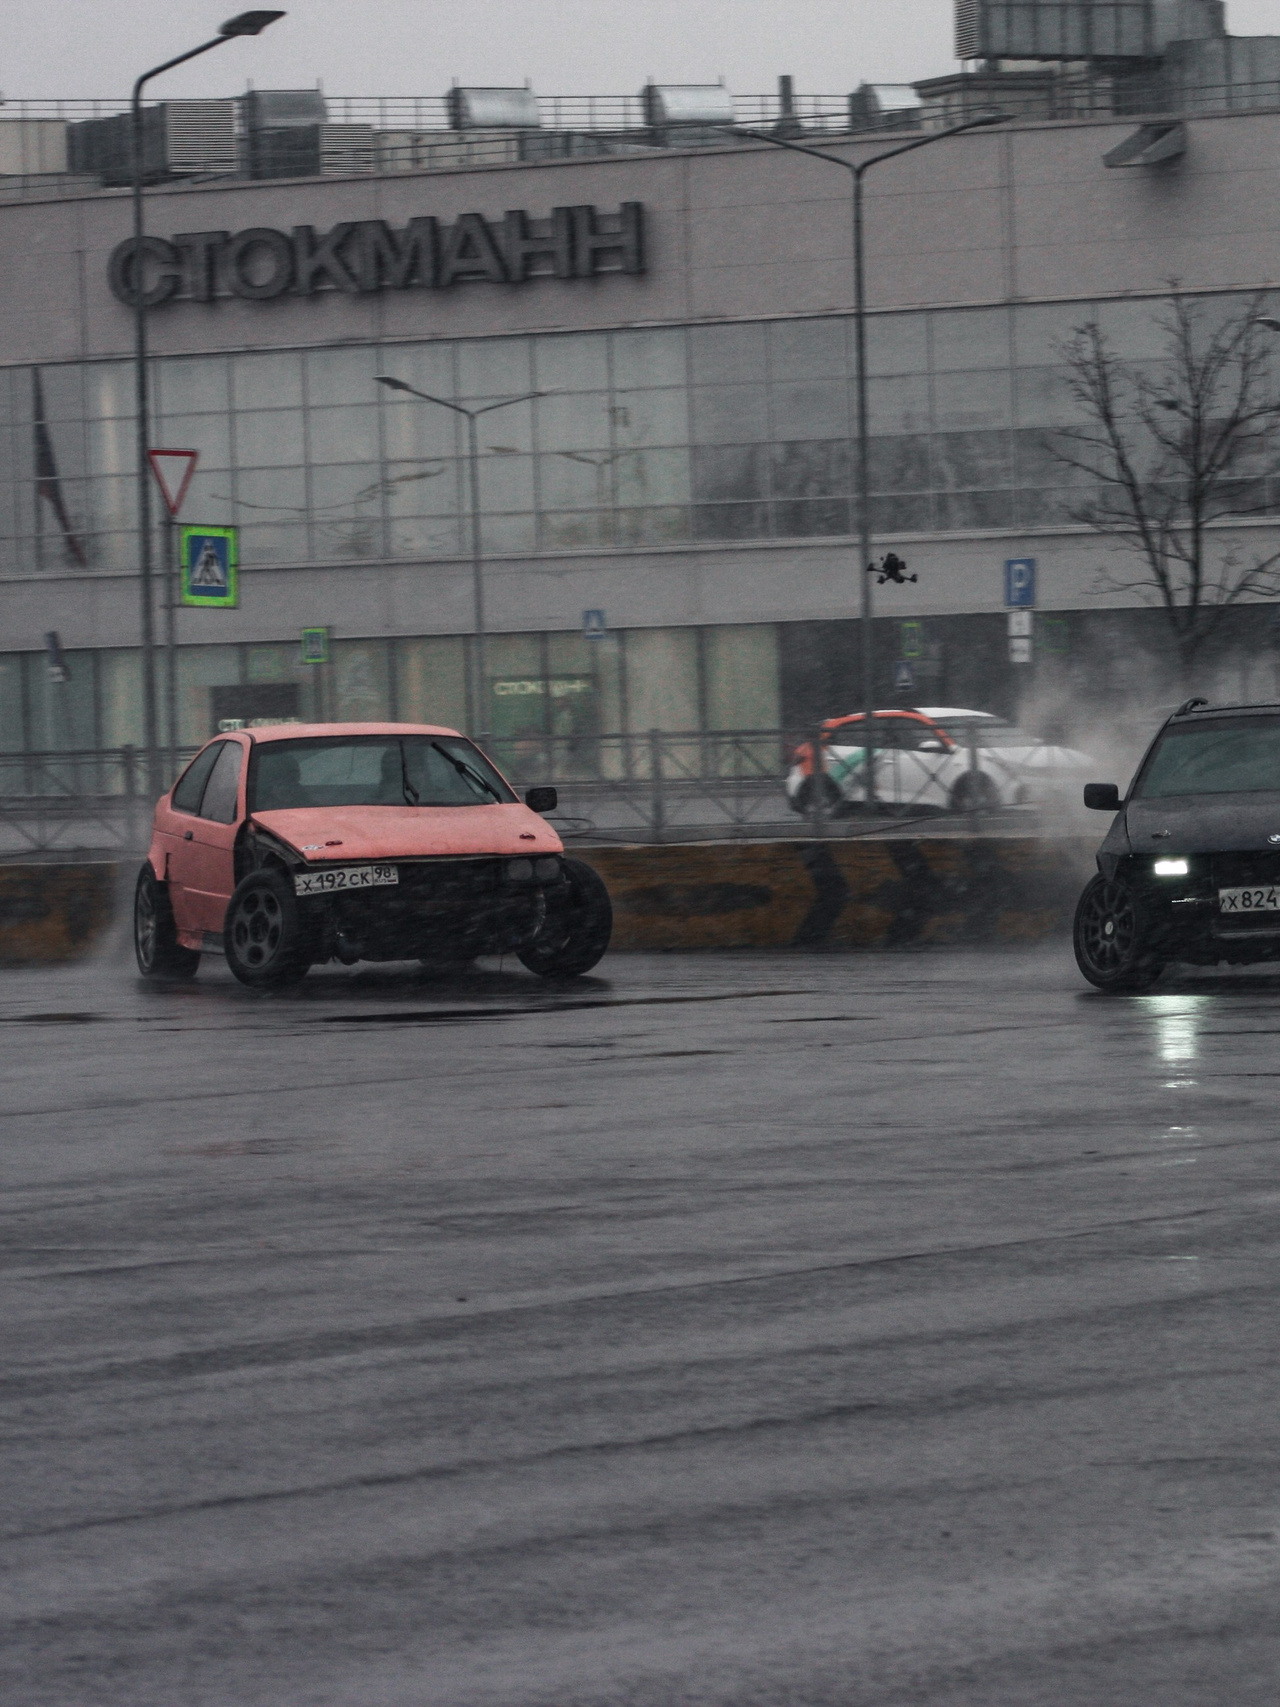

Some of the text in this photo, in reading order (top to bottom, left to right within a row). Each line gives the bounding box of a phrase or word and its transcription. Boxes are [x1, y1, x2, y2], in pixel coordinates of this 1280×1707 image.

[106, 200, 646, 307] СТОКМАНН
[1010, 564, 1030, 602] P
[374, 867, 391, 878] 98
